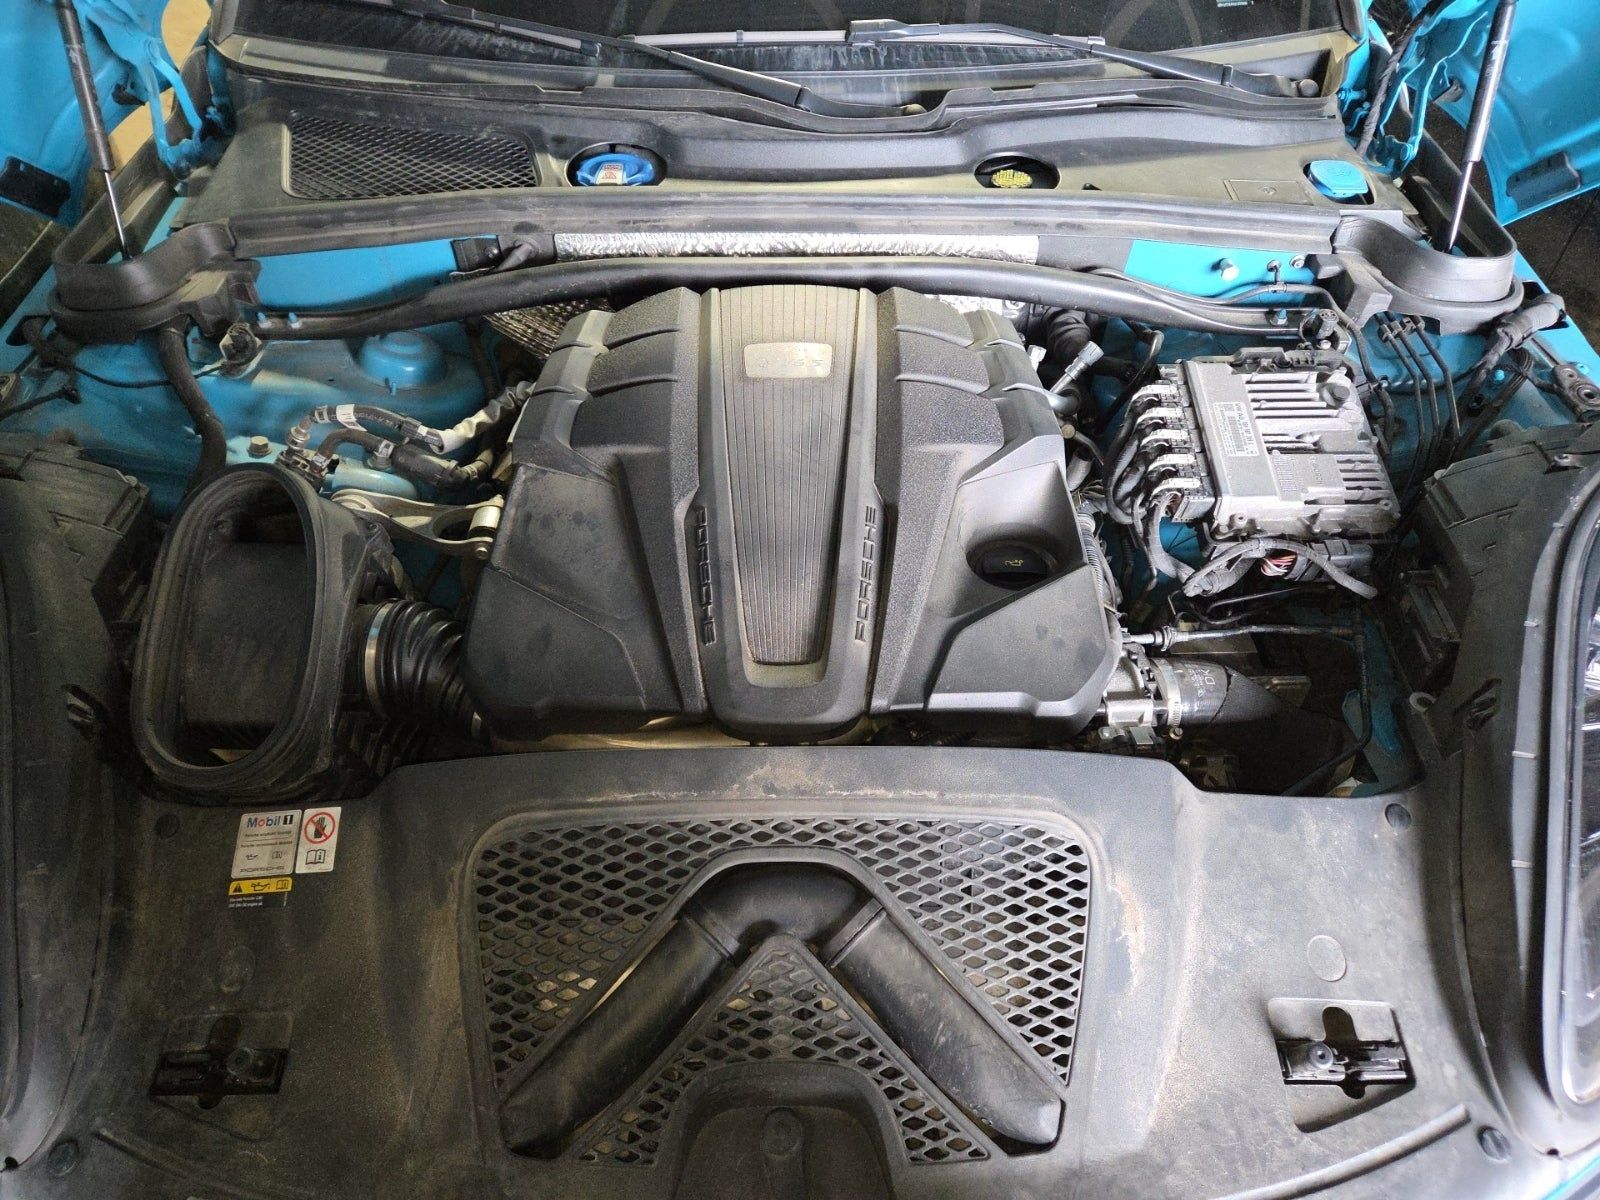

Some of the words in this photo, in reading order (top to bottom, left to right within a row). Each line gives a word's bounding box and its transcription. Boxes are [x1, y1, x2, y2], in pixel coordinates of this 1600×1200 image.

[695, 506, 717, 646] PORSCHE
[854, 506, 877, 642] PORSCHE
[247, 816, 281, 828] Mobil
[283, 815, 294, 825] 1
